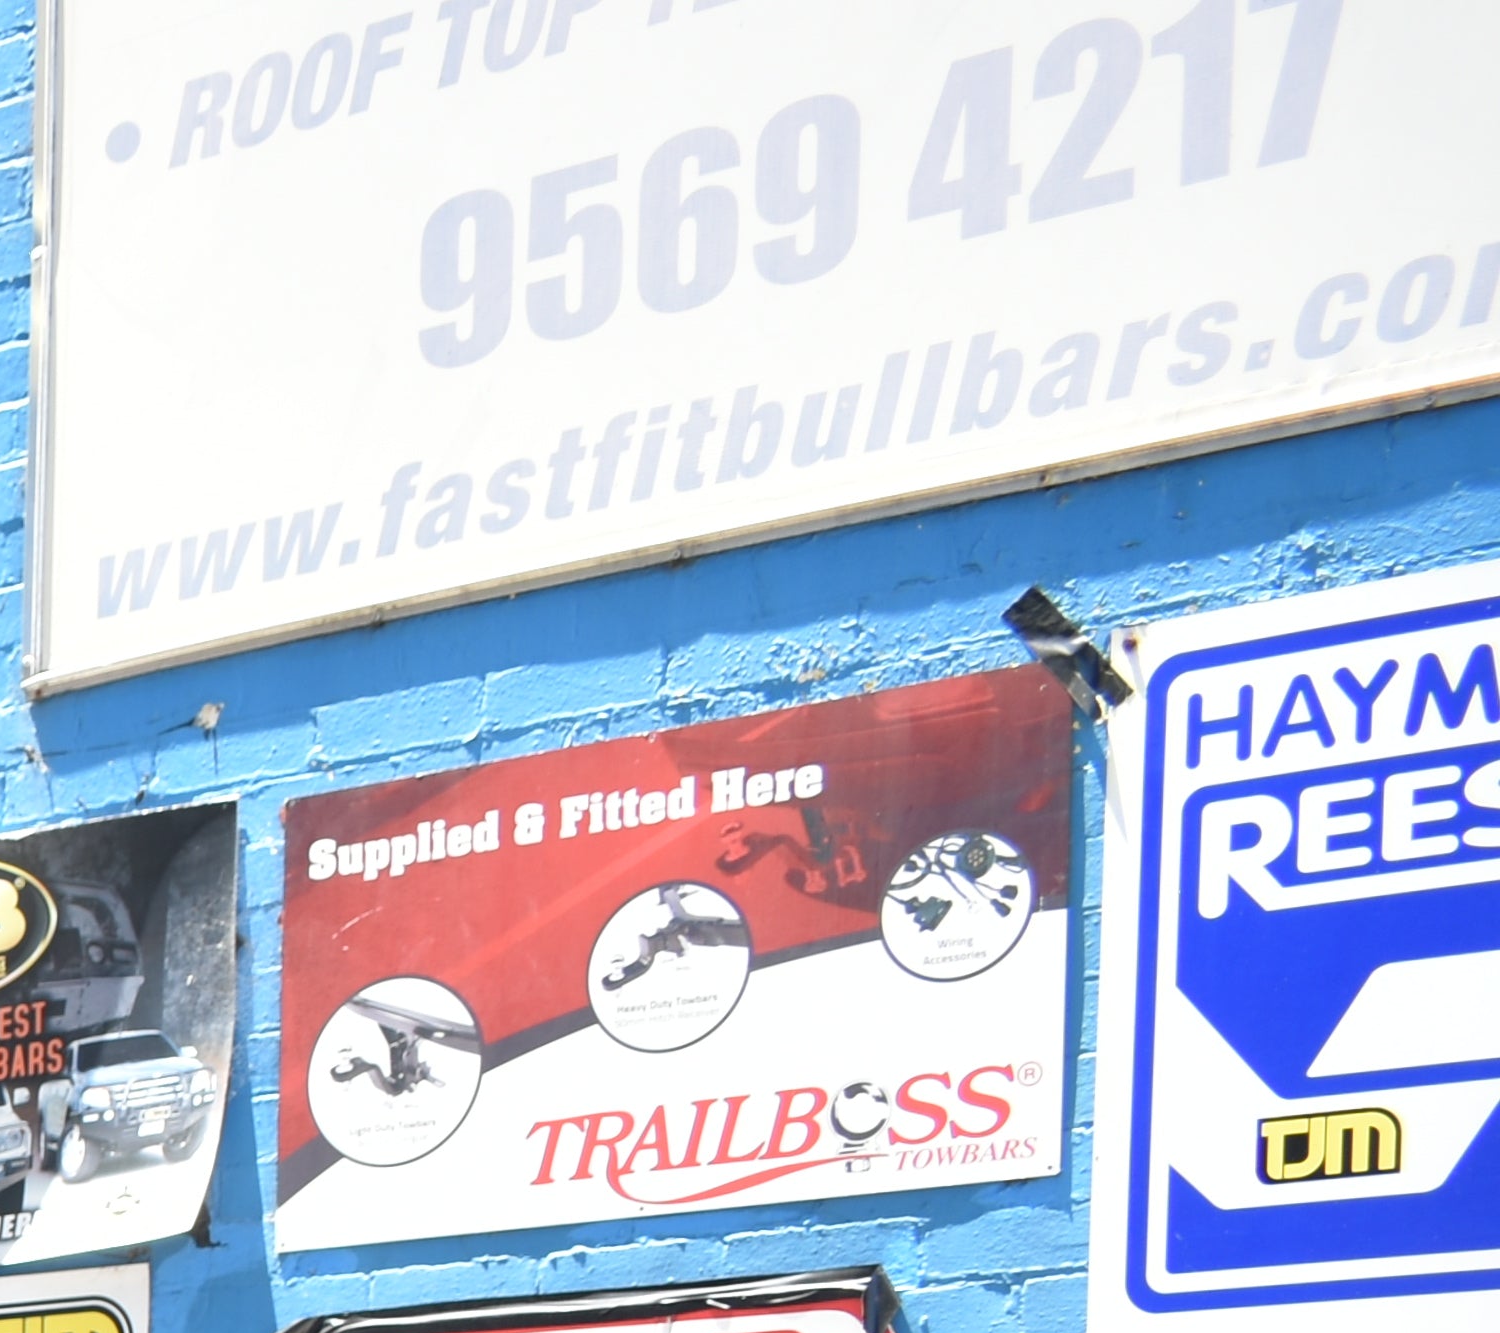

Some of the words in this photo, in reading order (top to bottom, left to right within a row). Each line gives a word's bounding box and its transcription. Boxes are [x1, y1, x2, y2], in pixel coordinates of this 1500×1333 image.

[169, 10, 413, 169] ROOF
[419, 93, 862, 370] 9569
[908, 0, 1345, 239] 4217
[1186, 643, 1500, 770] HAYM
[307, 809, 500, 883] Supplied
[512, 803, 544, 847] &
[560, 774, 697, 841] Fitted
[711, 763, 825, 814] Here
[923, 950, 987, 966] Accessories
[937, 937, 974, 949] Wiring
[526, 1064, 1015, 1190] TRAILBOSS
[895, 1136, 1038, 1172] TOWBARS
[1259, 1111, 1400, 1181] TJM
